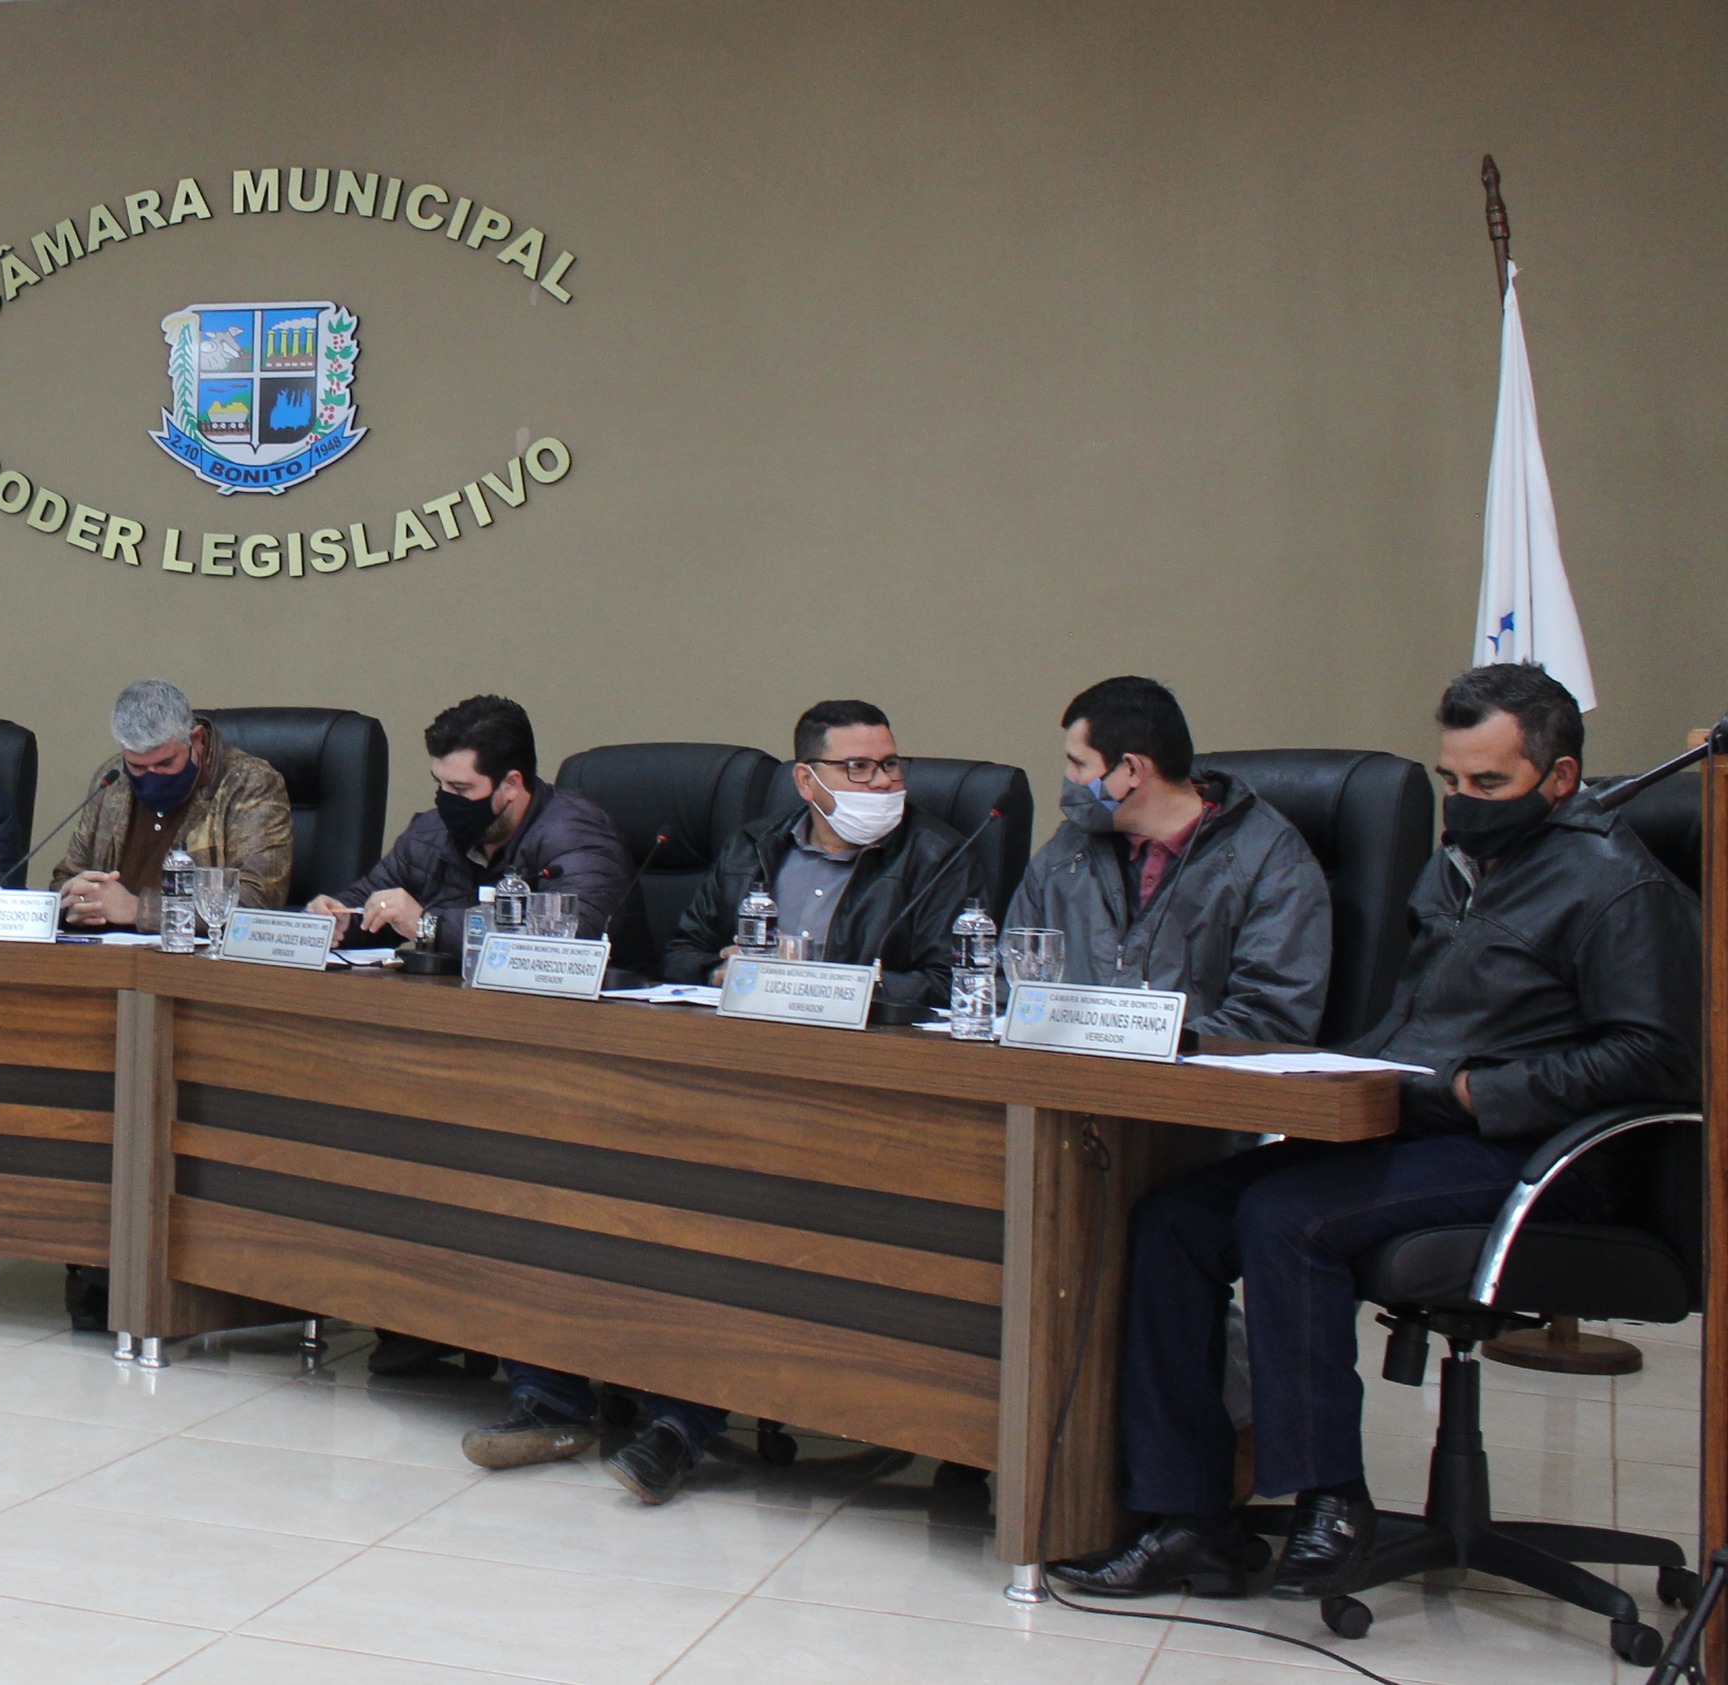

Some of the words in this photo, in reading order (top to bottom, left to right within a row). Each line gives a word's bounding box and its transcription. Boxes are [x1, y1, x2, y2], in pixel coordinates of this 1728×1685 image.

[232, 167, 575, 304] MUNICIPAL
[313, 436, 342, 459] 1948
[209, 461, 303, 484] BONITO
[162, 437, 571, 578] LEGISLATIVO
[31, 912, 48, 923] DIAS
[509, 957, 531, 970] PEDRO
[531, 959, 567, 974] APARECIDO
[535, 974, 564, 984] VEREADOR
[787, 969, 817, 979] MUNICIPAL
[829, 973, 852, 982] BONITO
[765, 981, 792, 995] LUCAS
[793, 983, 832, 999] LEANDRO
[833, 987, 855, 1001] PAES
[788, 1002, 825, 1013] VEREADOR
[1080, 996, 1117, 1006] MUNICIPAL
[1131, 1000, 1158, 1010] BONITO
[1163, 1003, 1175, 1011] MS
[1049, 1008, 1097, 1025] AURIVALDO
[1099, 1013, 1129, 1029] NUNES
[1130, 1016, 1167, 1035] FRANÇA
[1085, 1032, 1124, 1044] VEREADOR
